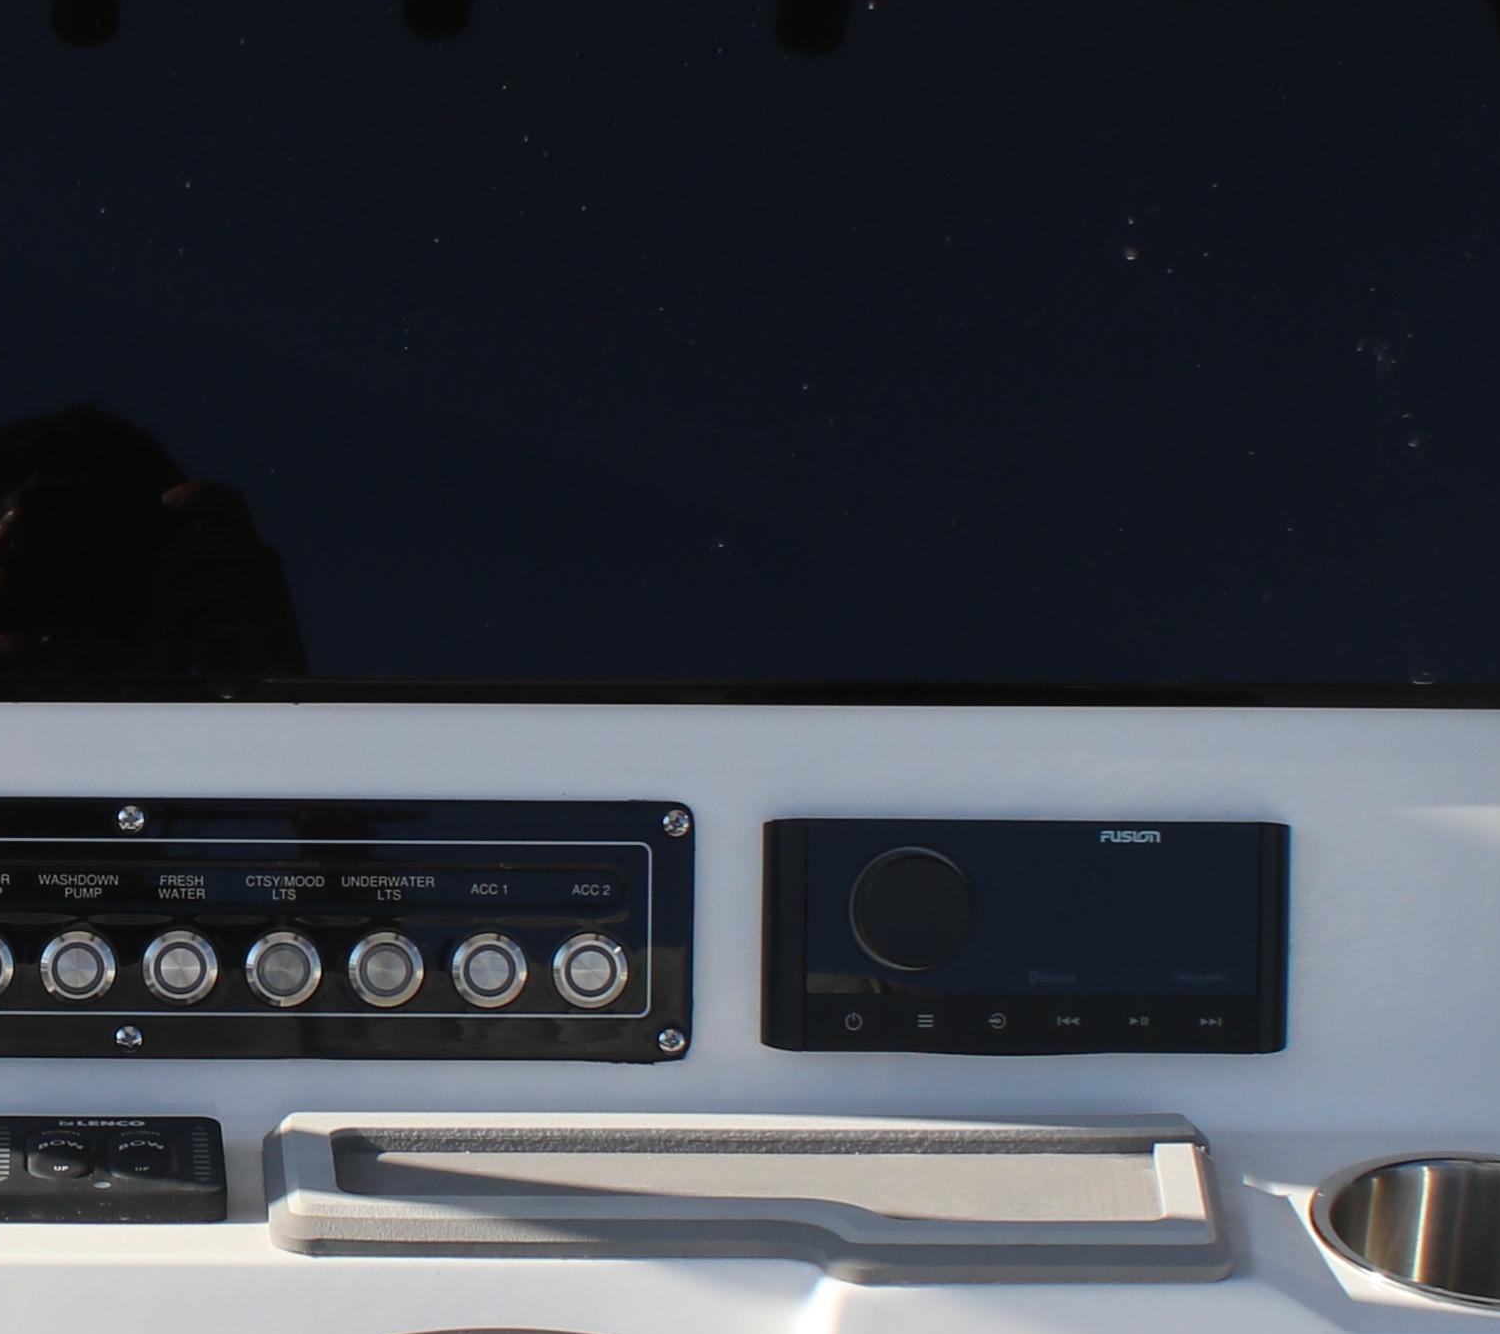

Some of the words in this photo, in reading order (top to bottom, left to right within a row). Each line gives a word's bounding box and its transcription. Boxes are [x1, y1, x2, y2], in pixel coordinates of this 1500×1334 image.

[1100, 830, 1161, 843] FUSION
[38, 874, 118, 886] WASHDOWN
[160, 875, 204, 887] FRESH
[246, 875, 325, 887] CTSY/MOOD
[341, 876, 434, 887] UNDERWATER
[65, 886, 102, 898] PUMP
[158, 888, 205, 899] WATER
[272, 889, 296, 900] LTS
[377, 889, 401, 900] LTS
[471, 883, 498, 895] ACC
[502, 883, 508, 895] 1
[572, 884, 598, 895] ACC
[600, 884, 610, 895] 2
[38, 1140, 84, 1150] BOW
[118, 1140, 165, 1151] BOW
